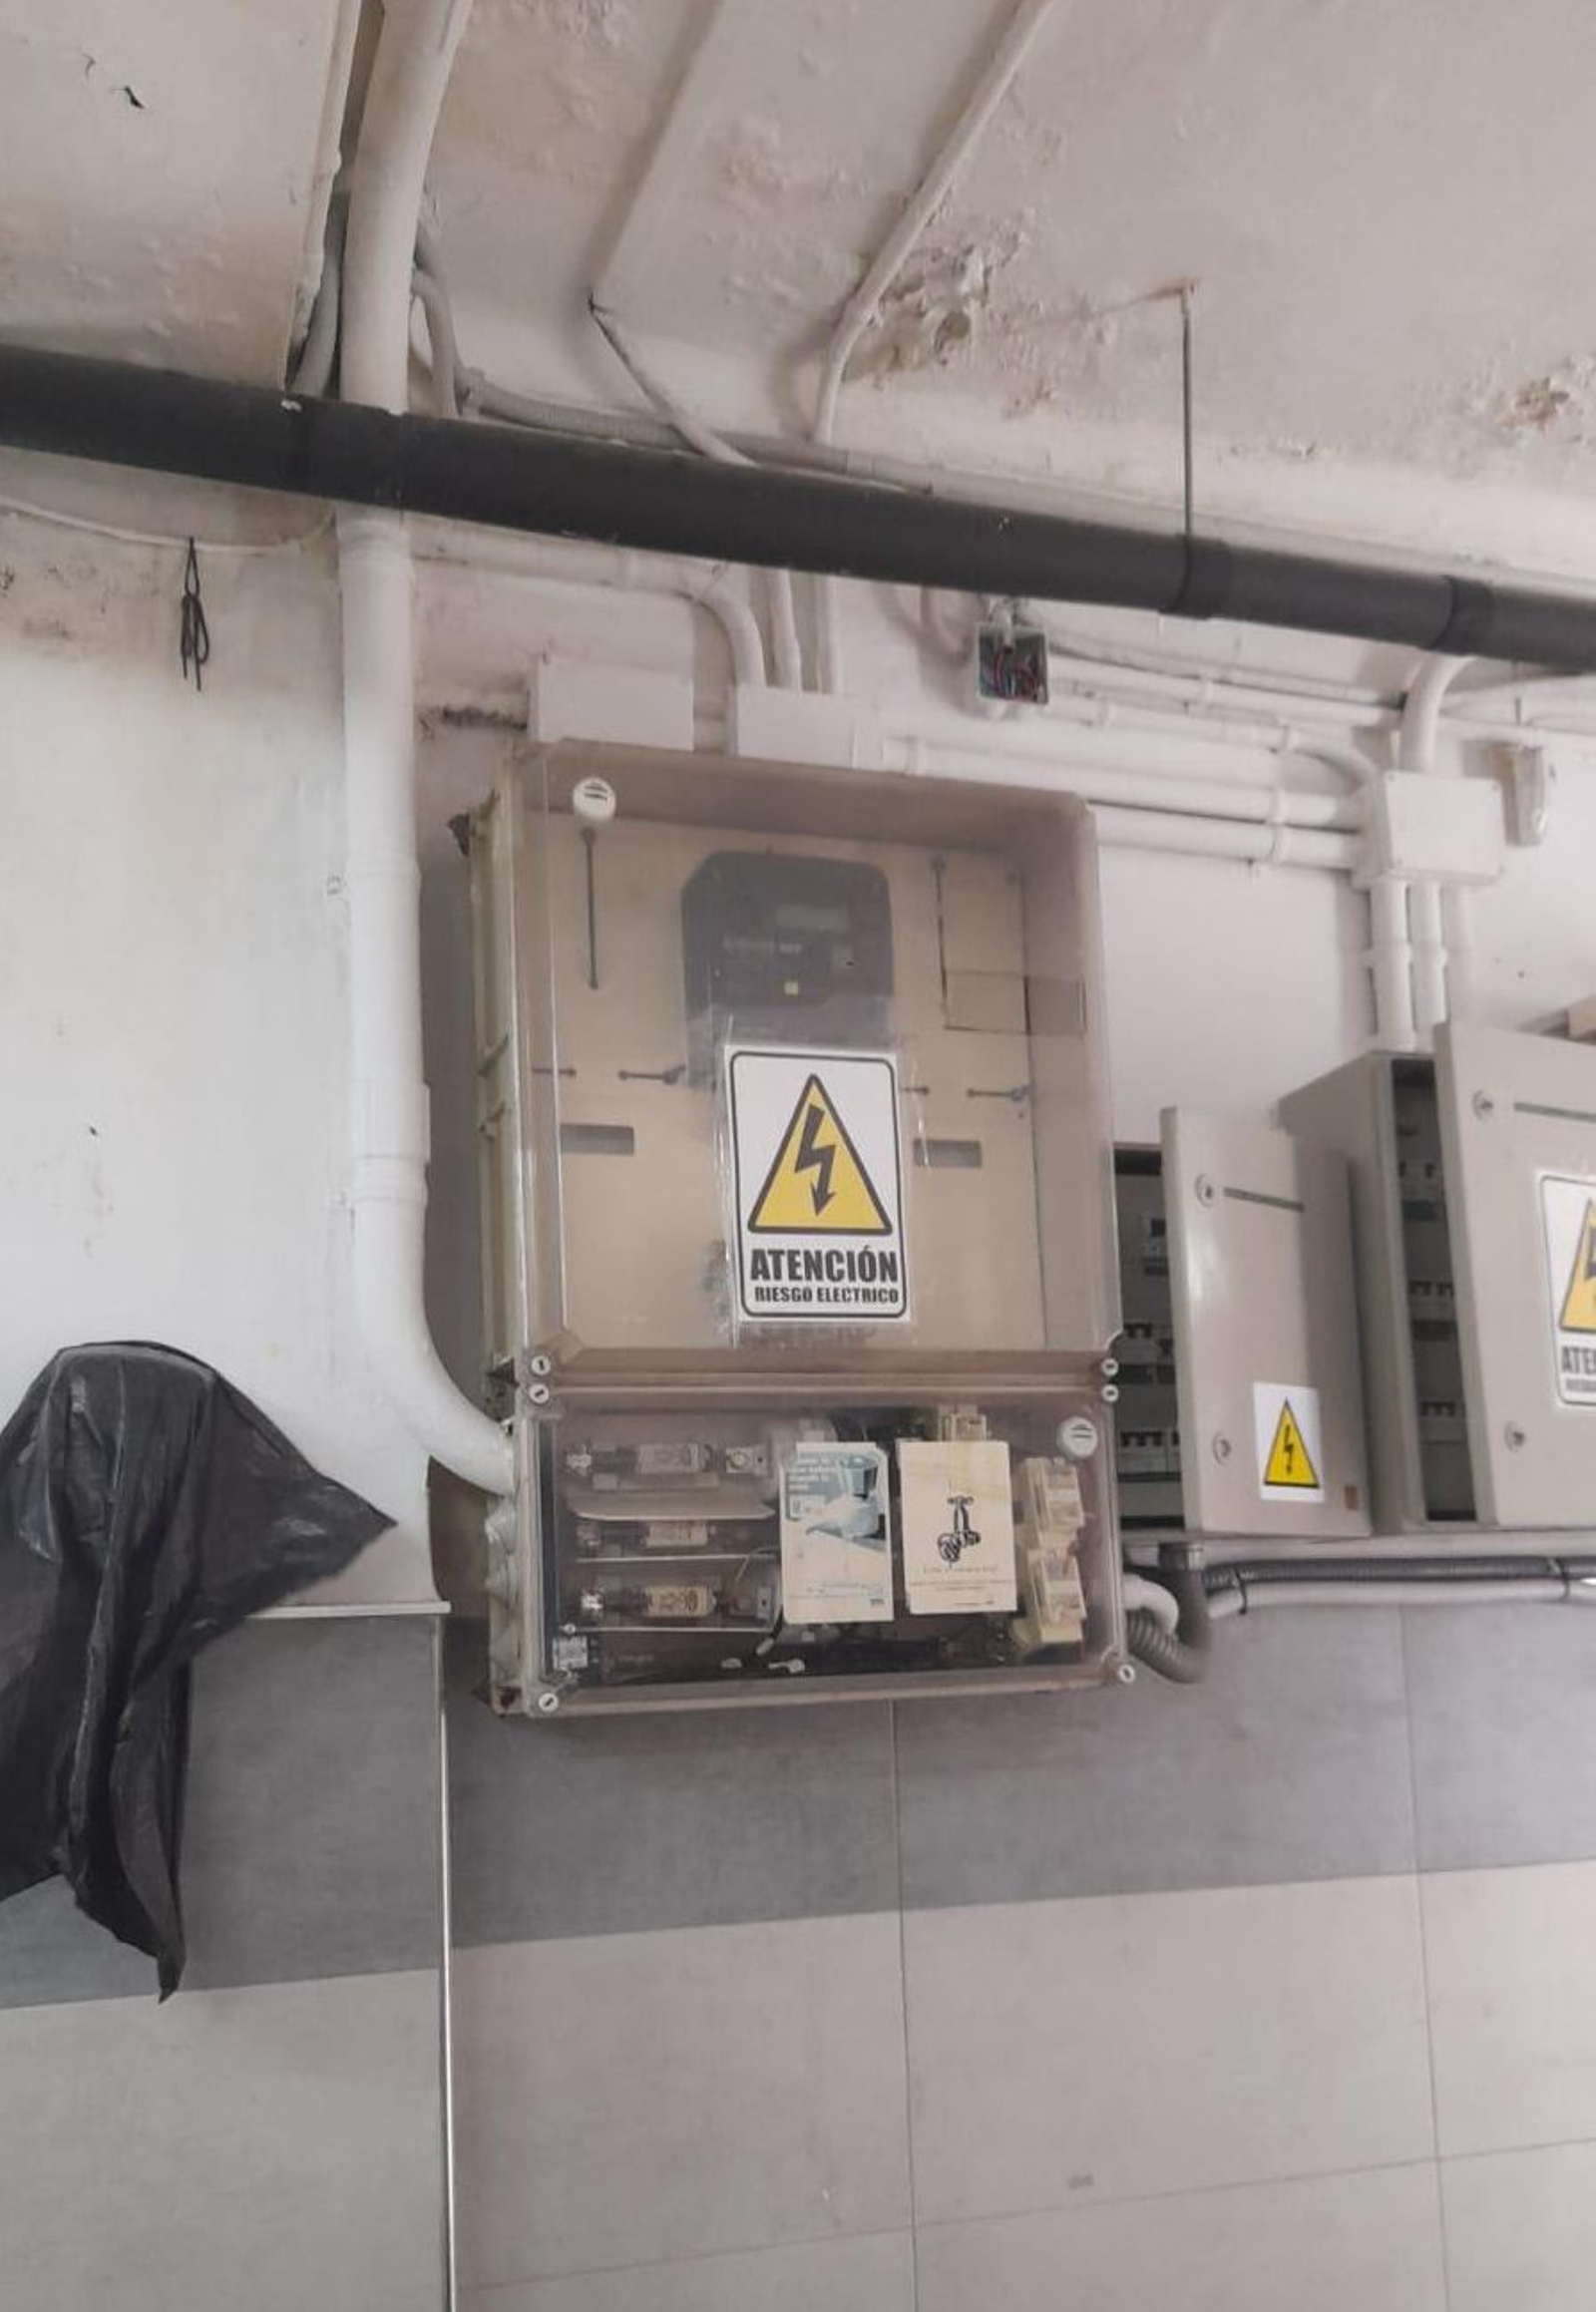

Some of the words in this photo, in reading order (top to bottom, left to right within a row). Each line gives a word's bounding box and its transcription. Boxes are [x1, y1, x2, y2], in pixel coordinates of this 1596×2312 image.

[750, 1245, 898, 1283] ATENCIÓN
[754, 1286, 813, 1302] RIESGO
[817, 1288, 899, 1304] ELECTRICO
[1562, 1346, 1596, 1375] ATE
